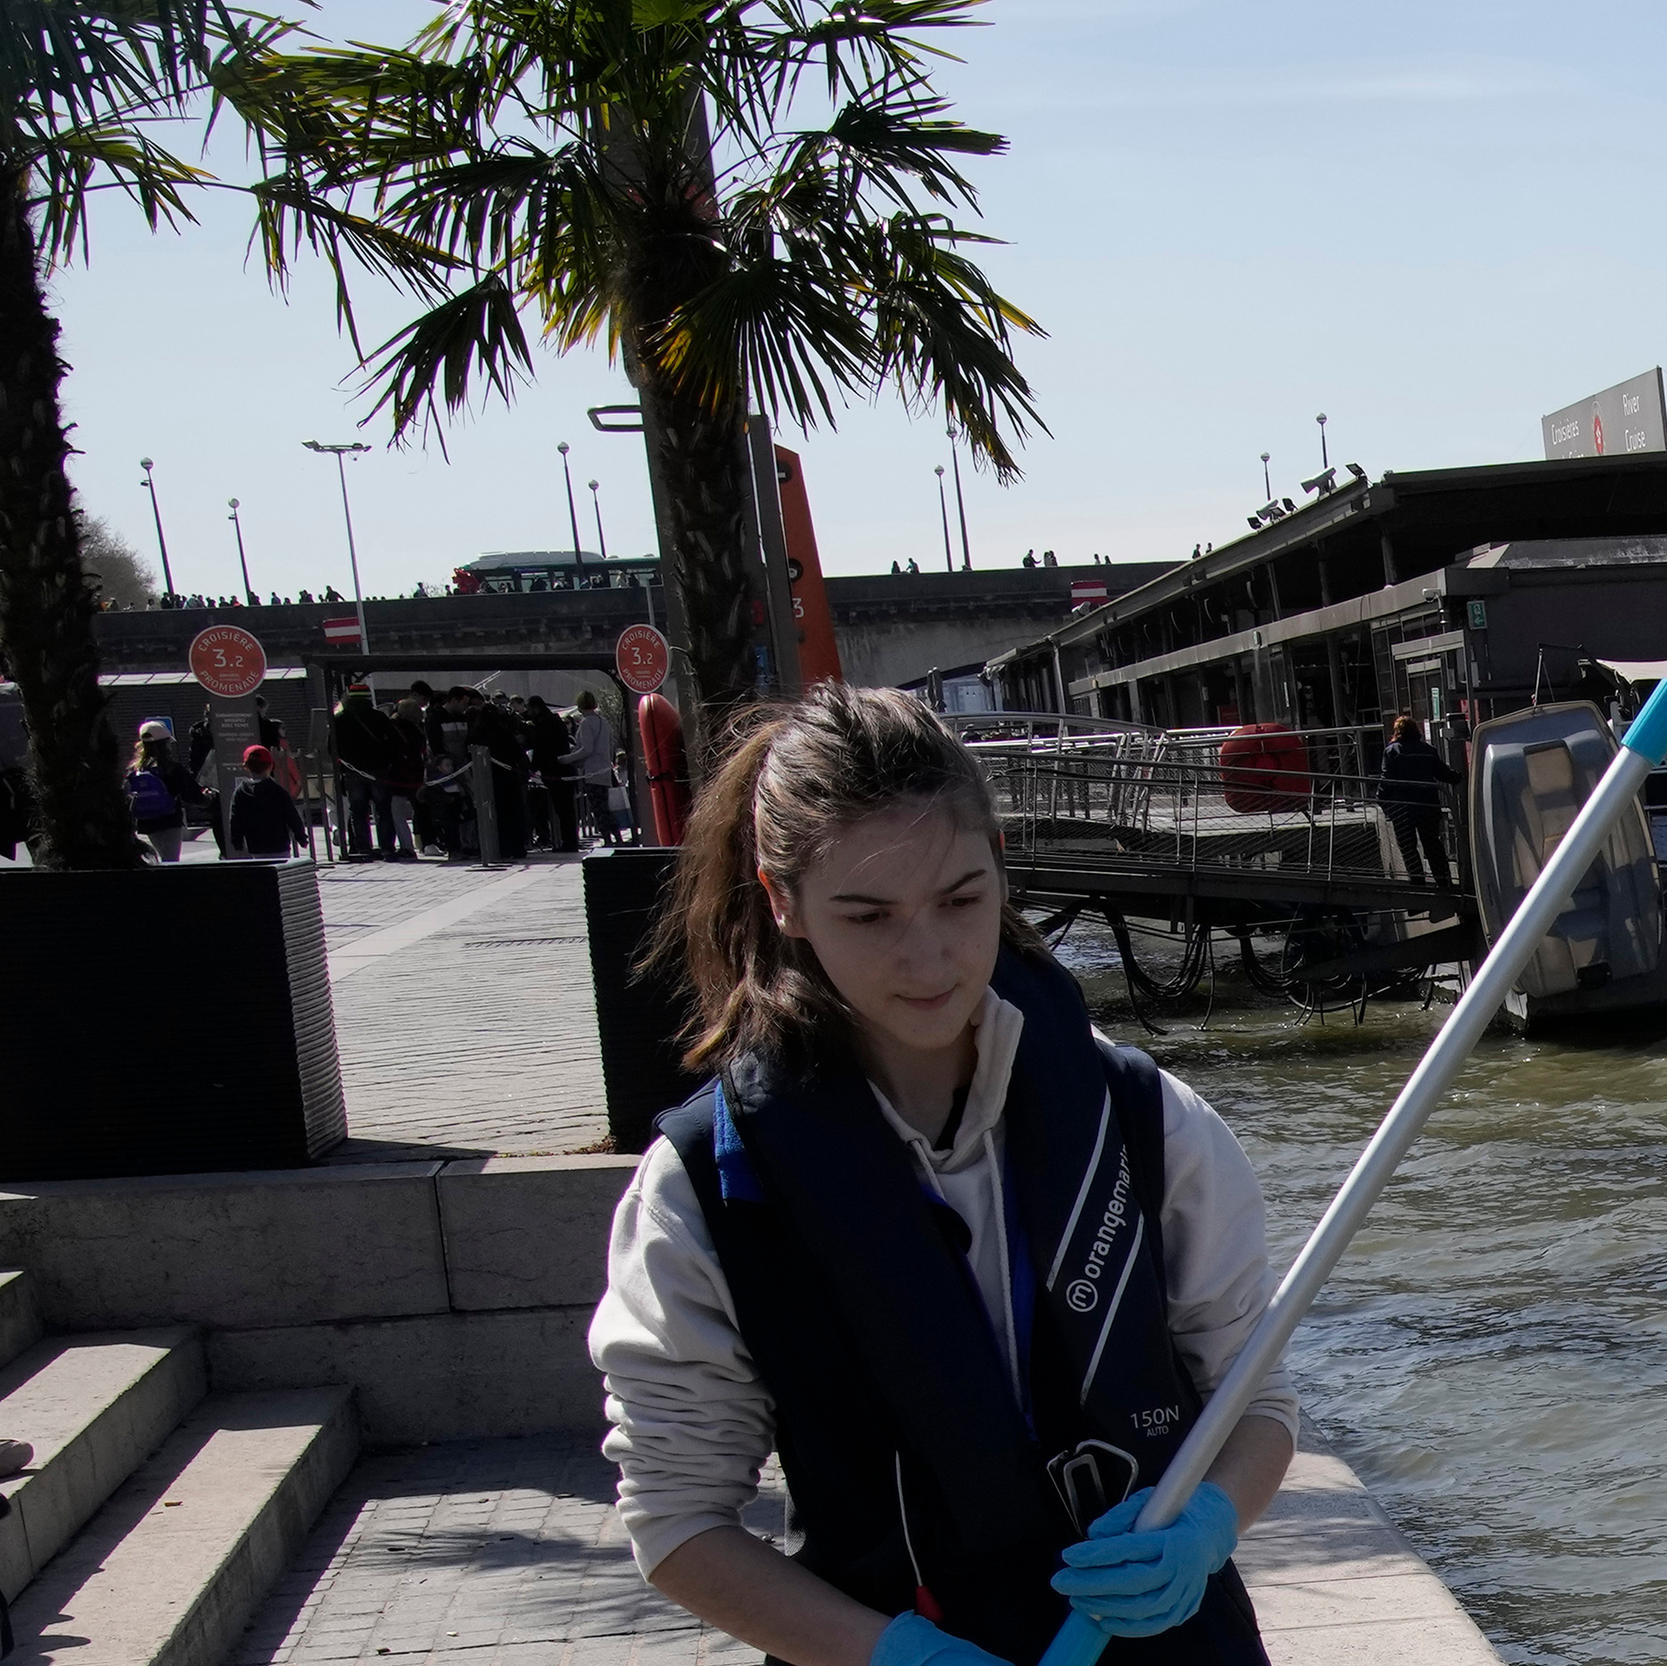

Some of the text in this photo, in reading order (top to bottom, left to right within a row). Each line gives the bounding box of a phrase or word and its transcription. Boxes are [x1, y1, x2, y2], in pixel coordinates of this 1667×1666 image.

[1622, 393, 1640, 416] River
[1551, 418, 1580, 445] Croisières
[1624, 426, 1647, 452] Cruise
[198, 630, 254, 652] CROISIÈRE
[622, 630, 661, 651] CROISIÈRE
[212, 649, 245, 668] 3.2
[631, 647, 654, 665] 3.2
[200, 670, 260, 692] PROMENADE
[622, 668, 665, 689] PROMENADE
[1130, 1405, 1180, 1429] 150N
[1146, 1425, 1169, 1437] AUTO
